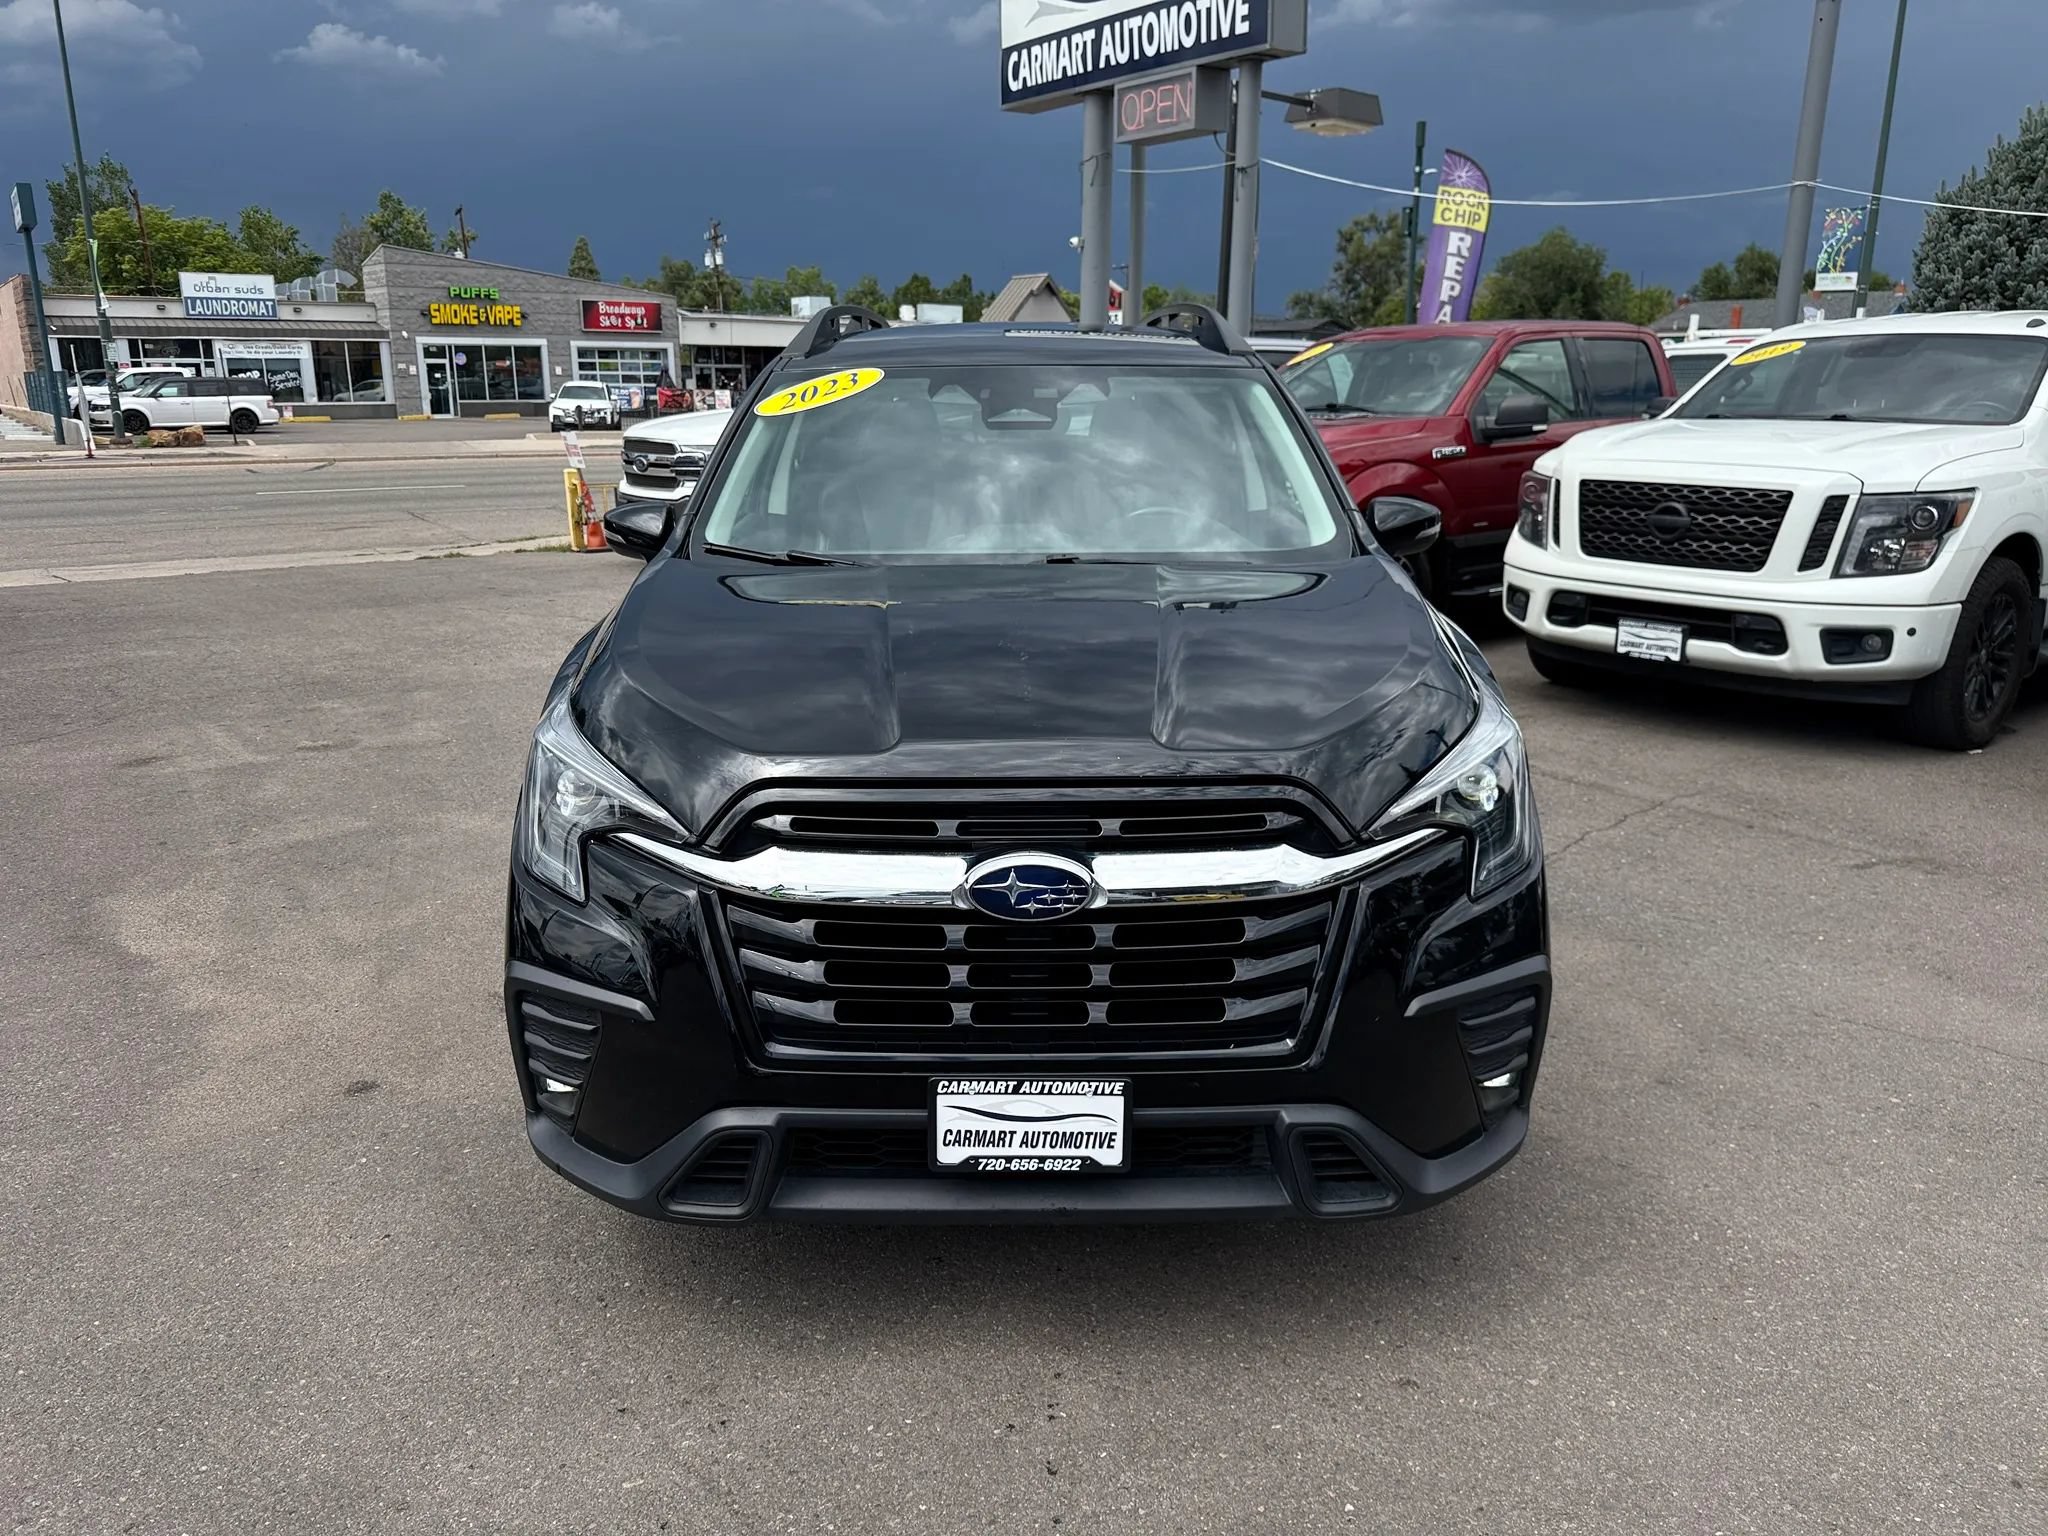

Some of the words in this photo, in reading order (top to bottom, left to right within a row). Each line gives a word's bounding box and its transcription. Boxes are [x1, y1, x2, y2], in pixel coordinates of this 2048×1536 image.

[1007, 27, 1097, 92] CARMART
[1099, 0, 1251, 69] AUTOMOTIVE
[1121, 81, 1193, 131] OPEN
[1439, 189, 1488, 211] ROCK
[1439, 207, 1482, 227] CHIP
[193, 280, 230, 294] urban
[234, 284, 265, 295] suds
[449, 286, 500, 300] PUFFS
[187, 298, 274, 316] LAUNDROMAT
[430, 303, 479, 325] SMOKE
[486, 305, 522, 327] VAPE
[779, 372, 859, 411] 2023
[936, 1080, 1018, 1094] CARMART
[1018, 1081, 1125, 1095] AUTOMOTIVE
[942, 1128, 1017, 1149] CARMART
[1019, 1130, 1118, 1150] AUTOMOTIVE
[977, 1158, 1082, 1171] 720-656-6922
